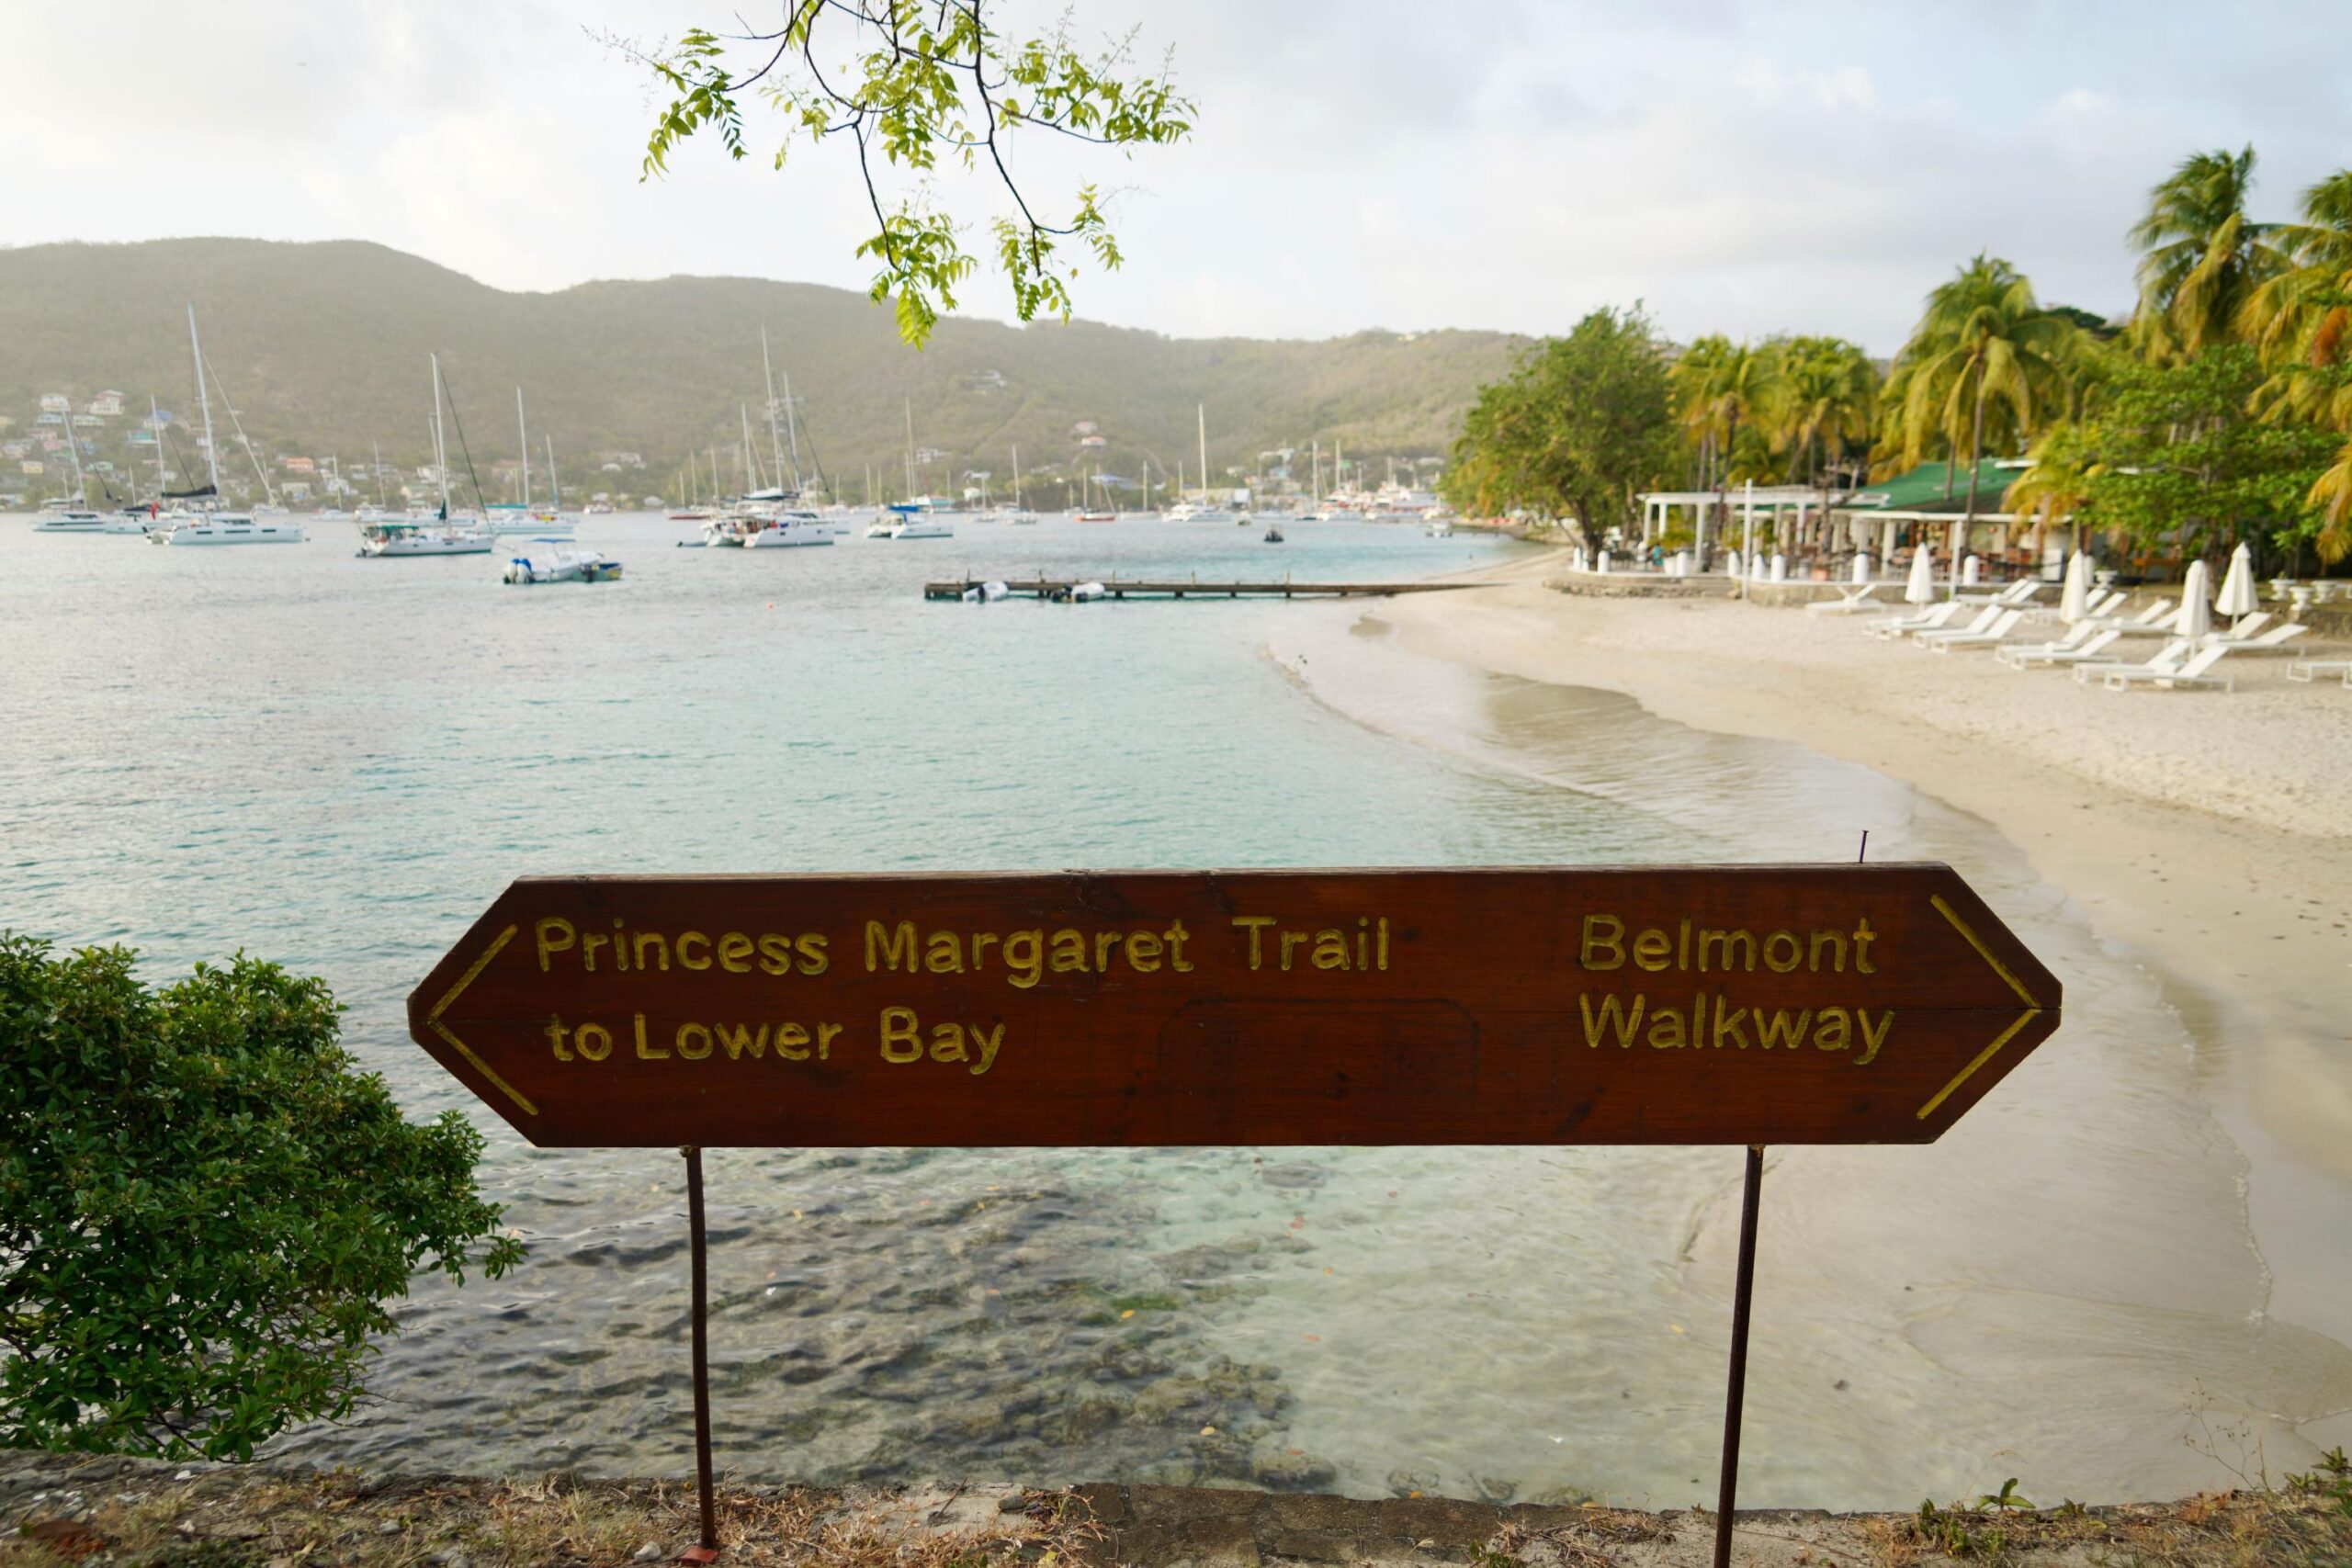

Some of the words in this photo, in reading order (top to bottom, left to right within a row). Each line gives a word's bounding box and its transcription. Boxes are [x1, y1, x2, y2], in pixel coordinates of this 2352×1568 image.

[536, 918, 831, 976] Princess
[865, 919, 1194, 989] Margaret
[1231, 916, 1390, 972] Trail
[1581, 913, 1877, 975] Belmont
[544, 1012, 613, 1063] to
[636, 1011, 843, 1062] Lower
[879, 1005, 1006, 1076] Bay
[1578, 991, 1895, 1066] Walkway
